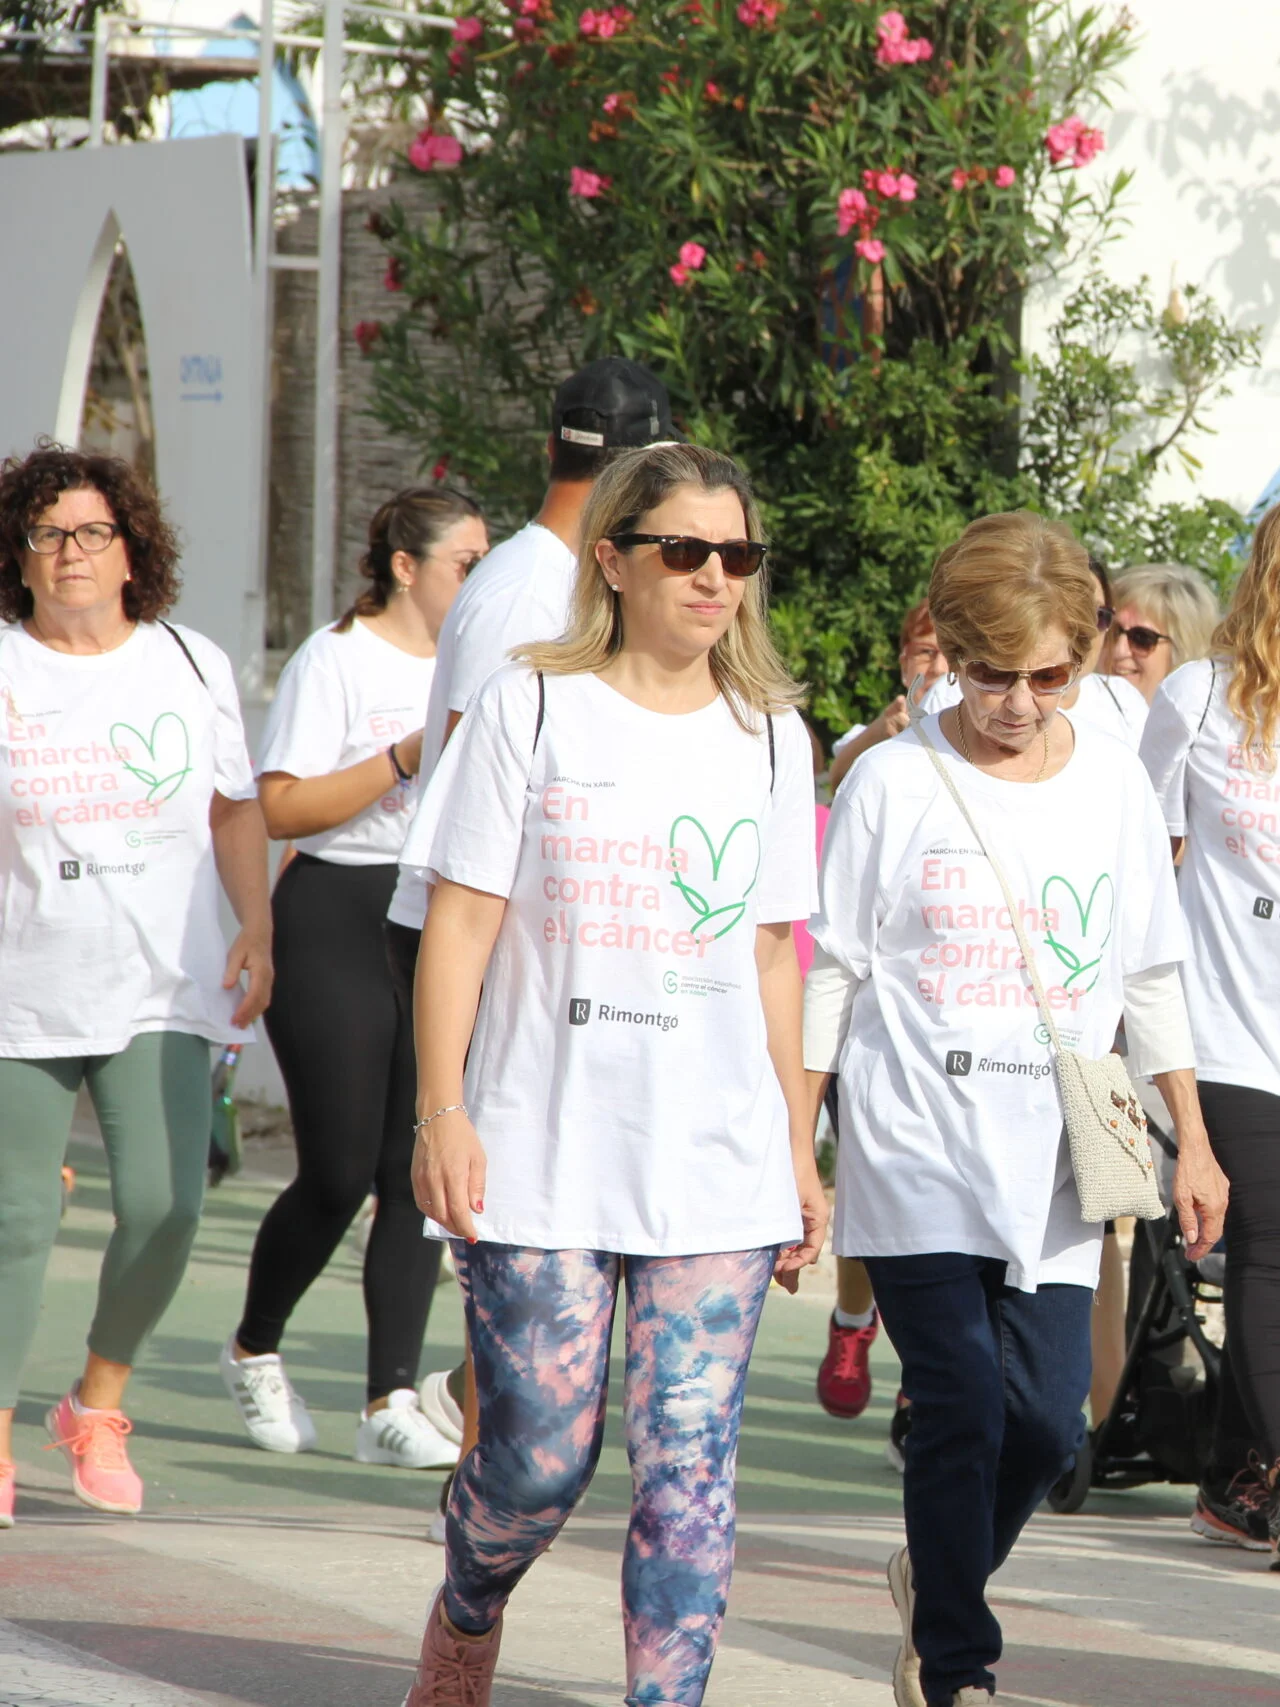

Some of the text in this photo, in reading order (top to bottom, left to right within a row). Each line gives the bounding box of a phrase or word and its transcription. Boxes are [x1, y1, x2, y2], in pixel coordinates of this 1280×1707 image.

[8, 721, 46, 742] En
[369, 716, 405, 738] En
[9, 740, 133, 768] marcha
[10, 770, 119, 798] contra
[15, 798, 166, 827] el cáncer
[541, 786, 589, 821] En
[541, 833, 689, 875] marcha
[1225, 833, 1248, 859] el
[921, 859, 966, 891] En
[543, 873, 661, 911] contra
[921, 899, 1060, 932] marcha
[543, 909, 716, 958] el cáncer
[917, 973, 946, 1005] el
[598, 1004, 679, 1031] Rimontgó
[977, 1057, 1051, 1080] Rimontgó
